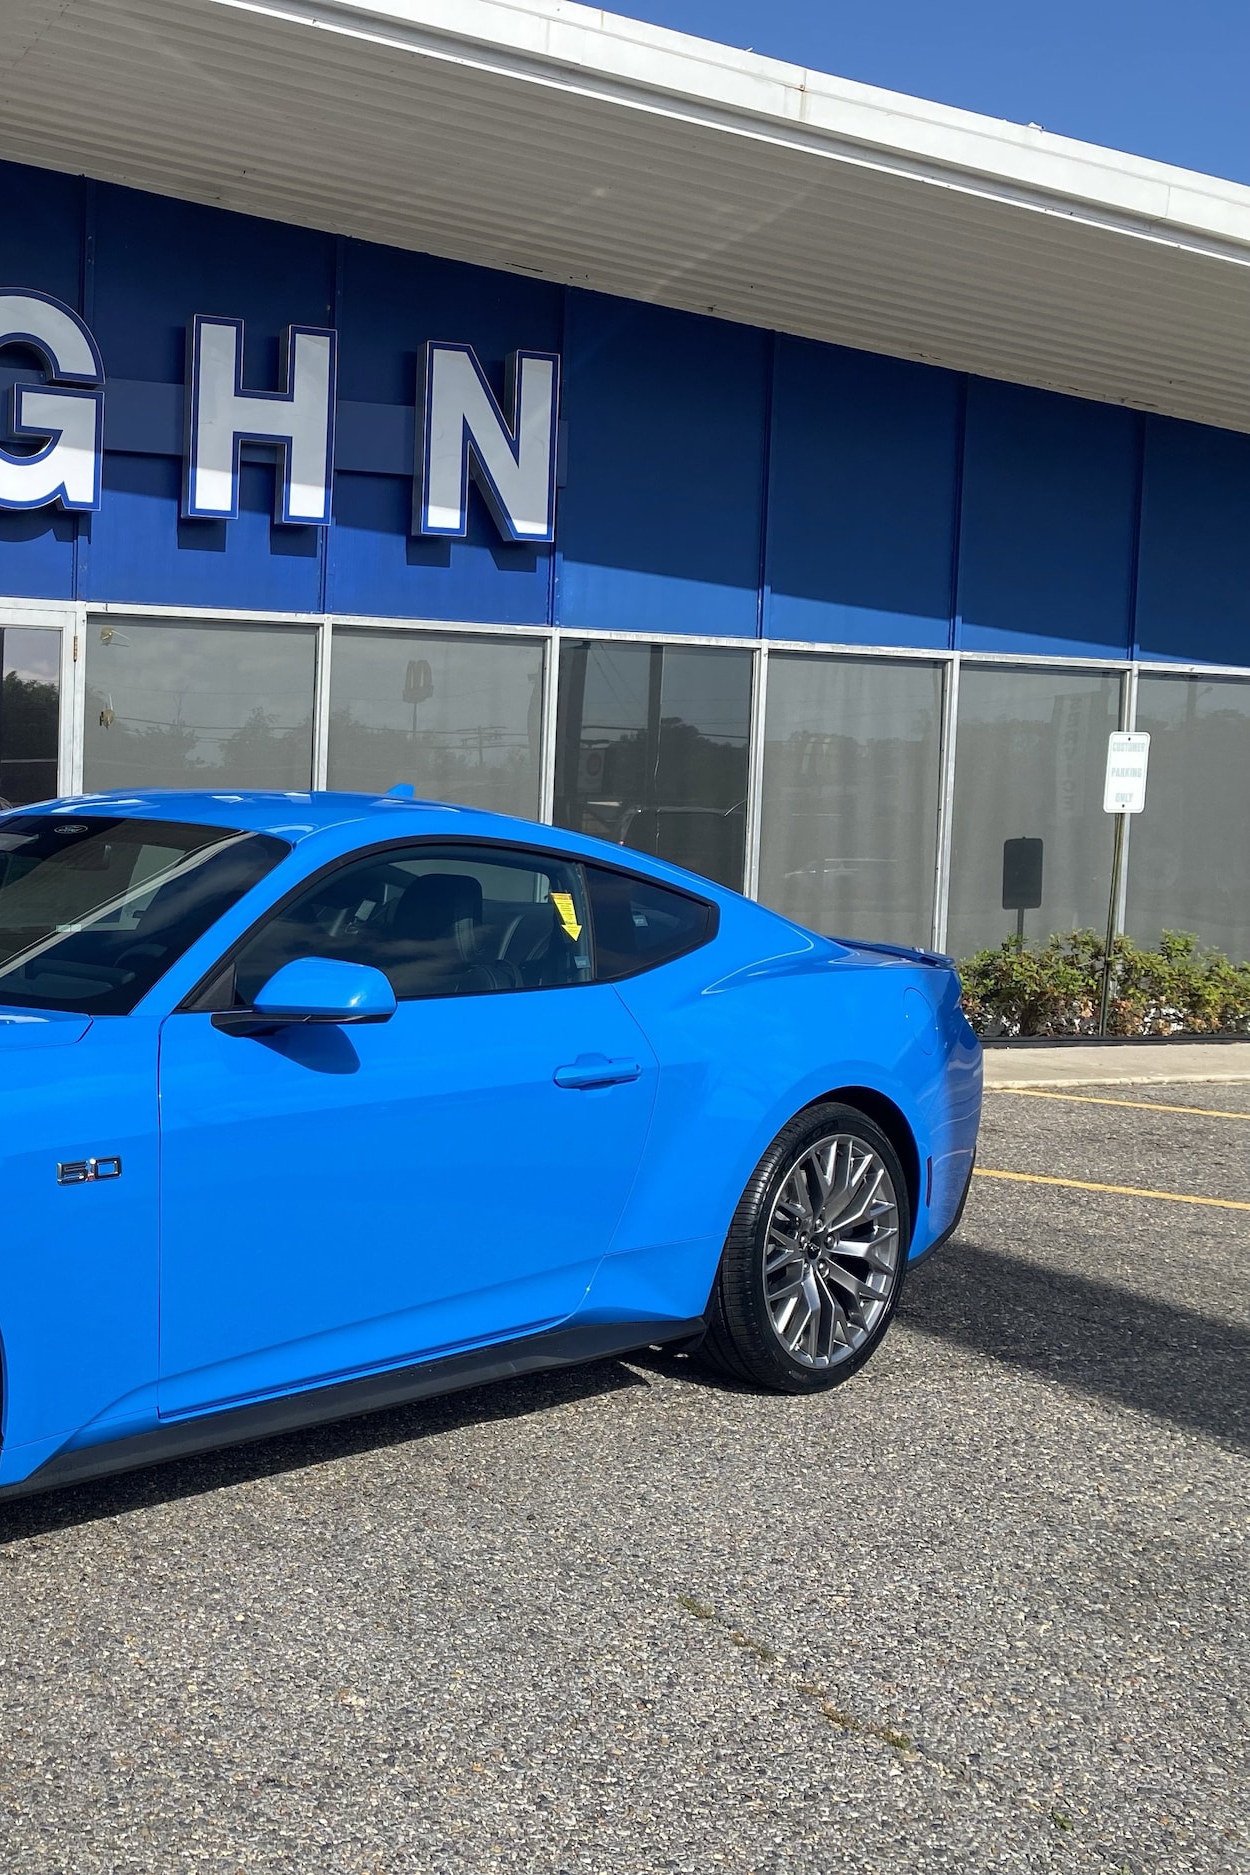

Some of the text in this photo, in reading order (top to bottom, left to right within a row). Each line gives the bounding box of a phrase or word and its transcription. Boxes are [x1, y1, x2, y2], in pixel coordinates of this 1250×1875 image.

[1112, 743, 1145, 753] CUSTOMER
[1111, 768, 1142, 778] PARKING
[1115, 793, 1134, 802] ONLY
